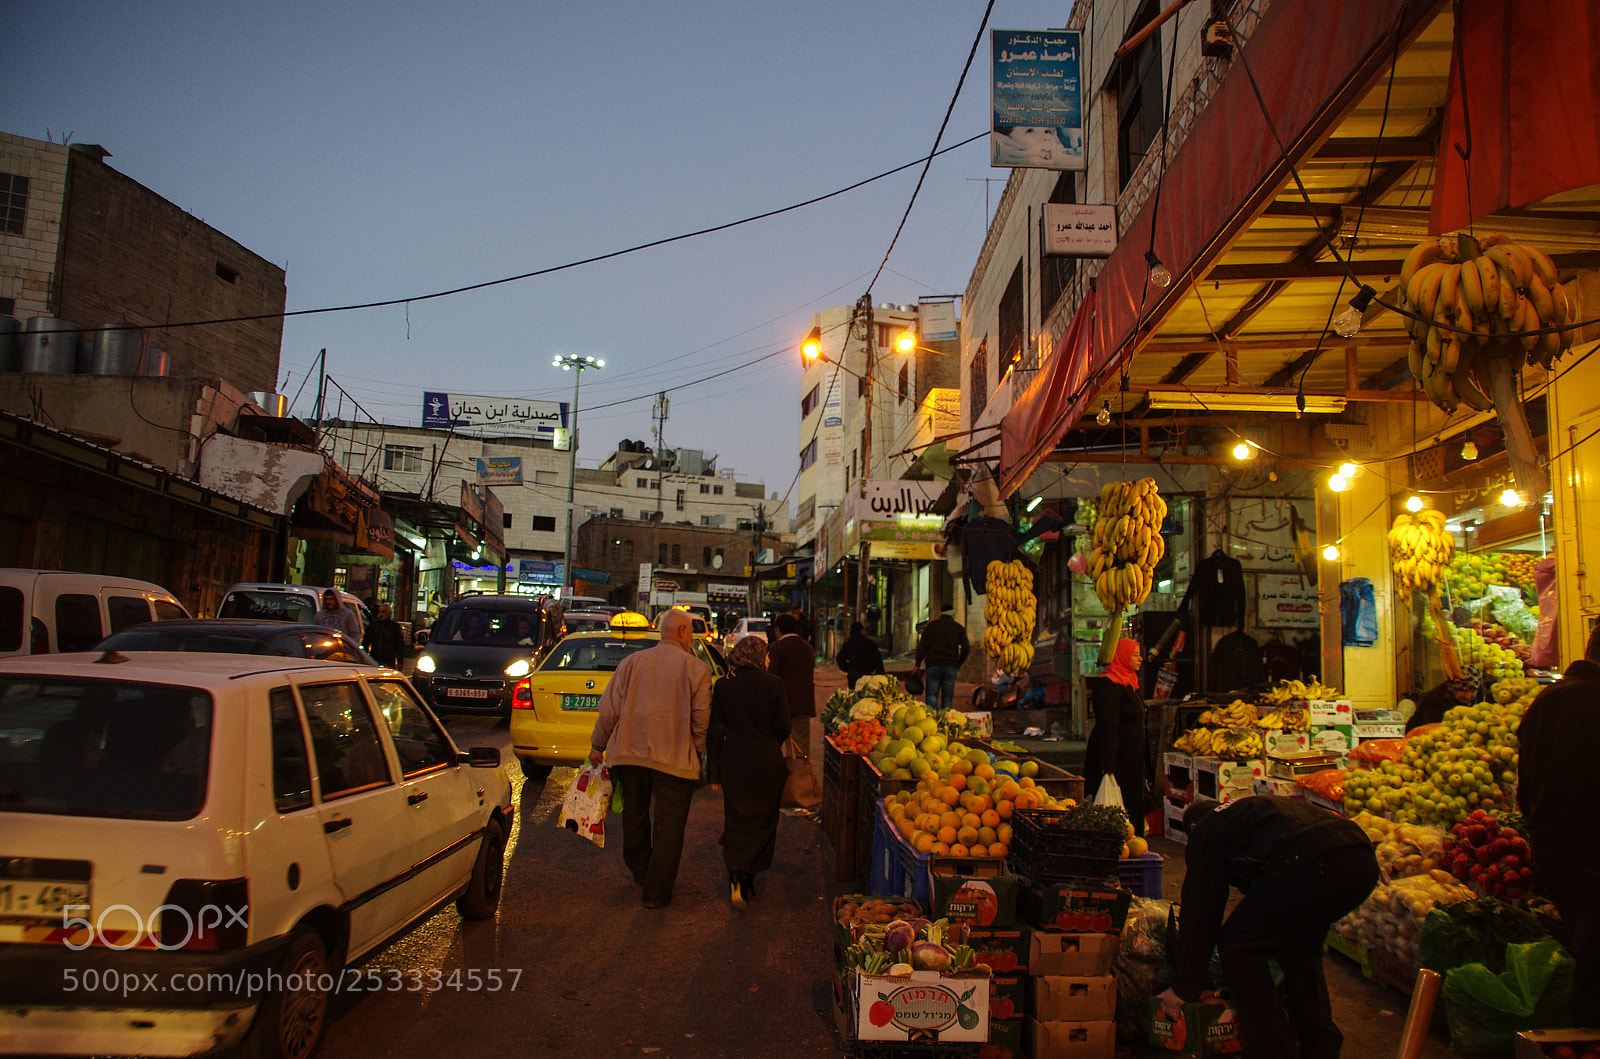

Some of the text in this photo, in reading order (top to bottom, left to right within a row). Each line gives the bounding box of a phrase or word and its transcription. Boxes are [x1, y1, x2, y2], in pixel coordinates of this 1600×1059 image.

[1008, 34, 1067, 47] مجمع الدكتور
[998, 46, 1076, 63] أحمد عمرو
[451, 400, 559, 424] صيدلية ابن حيان
[949, 903, 975, 912] ירקות
[901, 990, 949, 1005] חרמון
[895, 1011, 921, 1019] שמס
[1207, 1024, 1233, 1037] ירקות
